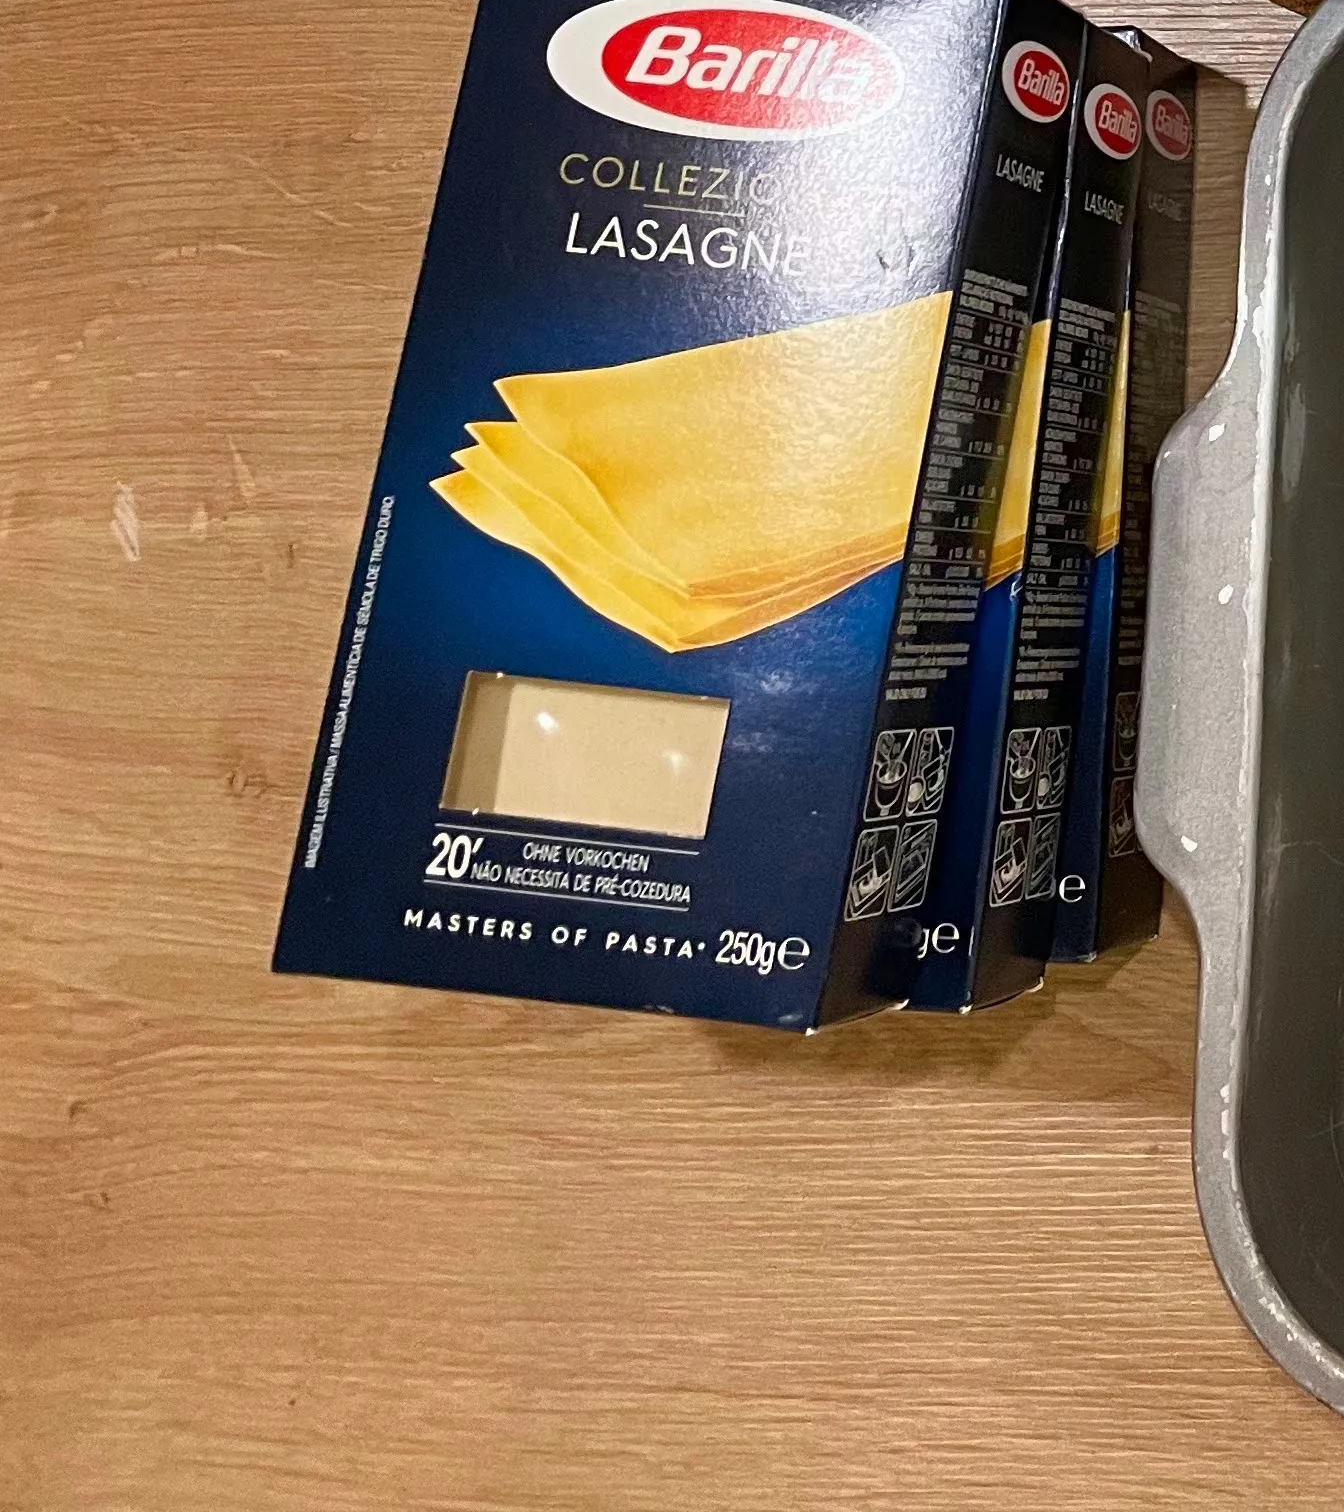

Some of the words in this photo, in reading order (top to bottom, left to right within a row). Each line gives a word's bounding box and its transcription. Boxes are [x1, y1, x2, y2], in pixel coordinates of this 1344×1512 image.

[625, 25, 871, 105] Barilla
[1017, 58, 1065, 106] Barilla
[1098, 99, 1137, 144] Barilla
[996, 154, 1044, 193] LASAGNE
[1084, 191, 1125, 224] LASAGNE
[565, 211, 811, 277] LASAGNE
[369, 529, 387, 563] TRIGO
[366, 565, 380, 580] DE
[353, 627, 366, 643] DE
[330, 710, 348, 748] MASSA
[470, 860, 501, 881] NÃO
[505, 865, 570, 889] NECESSITA
[573, 873, 592, 892] DE
[522, 842, 560, 863] OHNE
[566, 846, 650, 873] VORKOCHEN
[403, 908, 533, 941] MASTERS
[550, 925, 589, 947] OF
